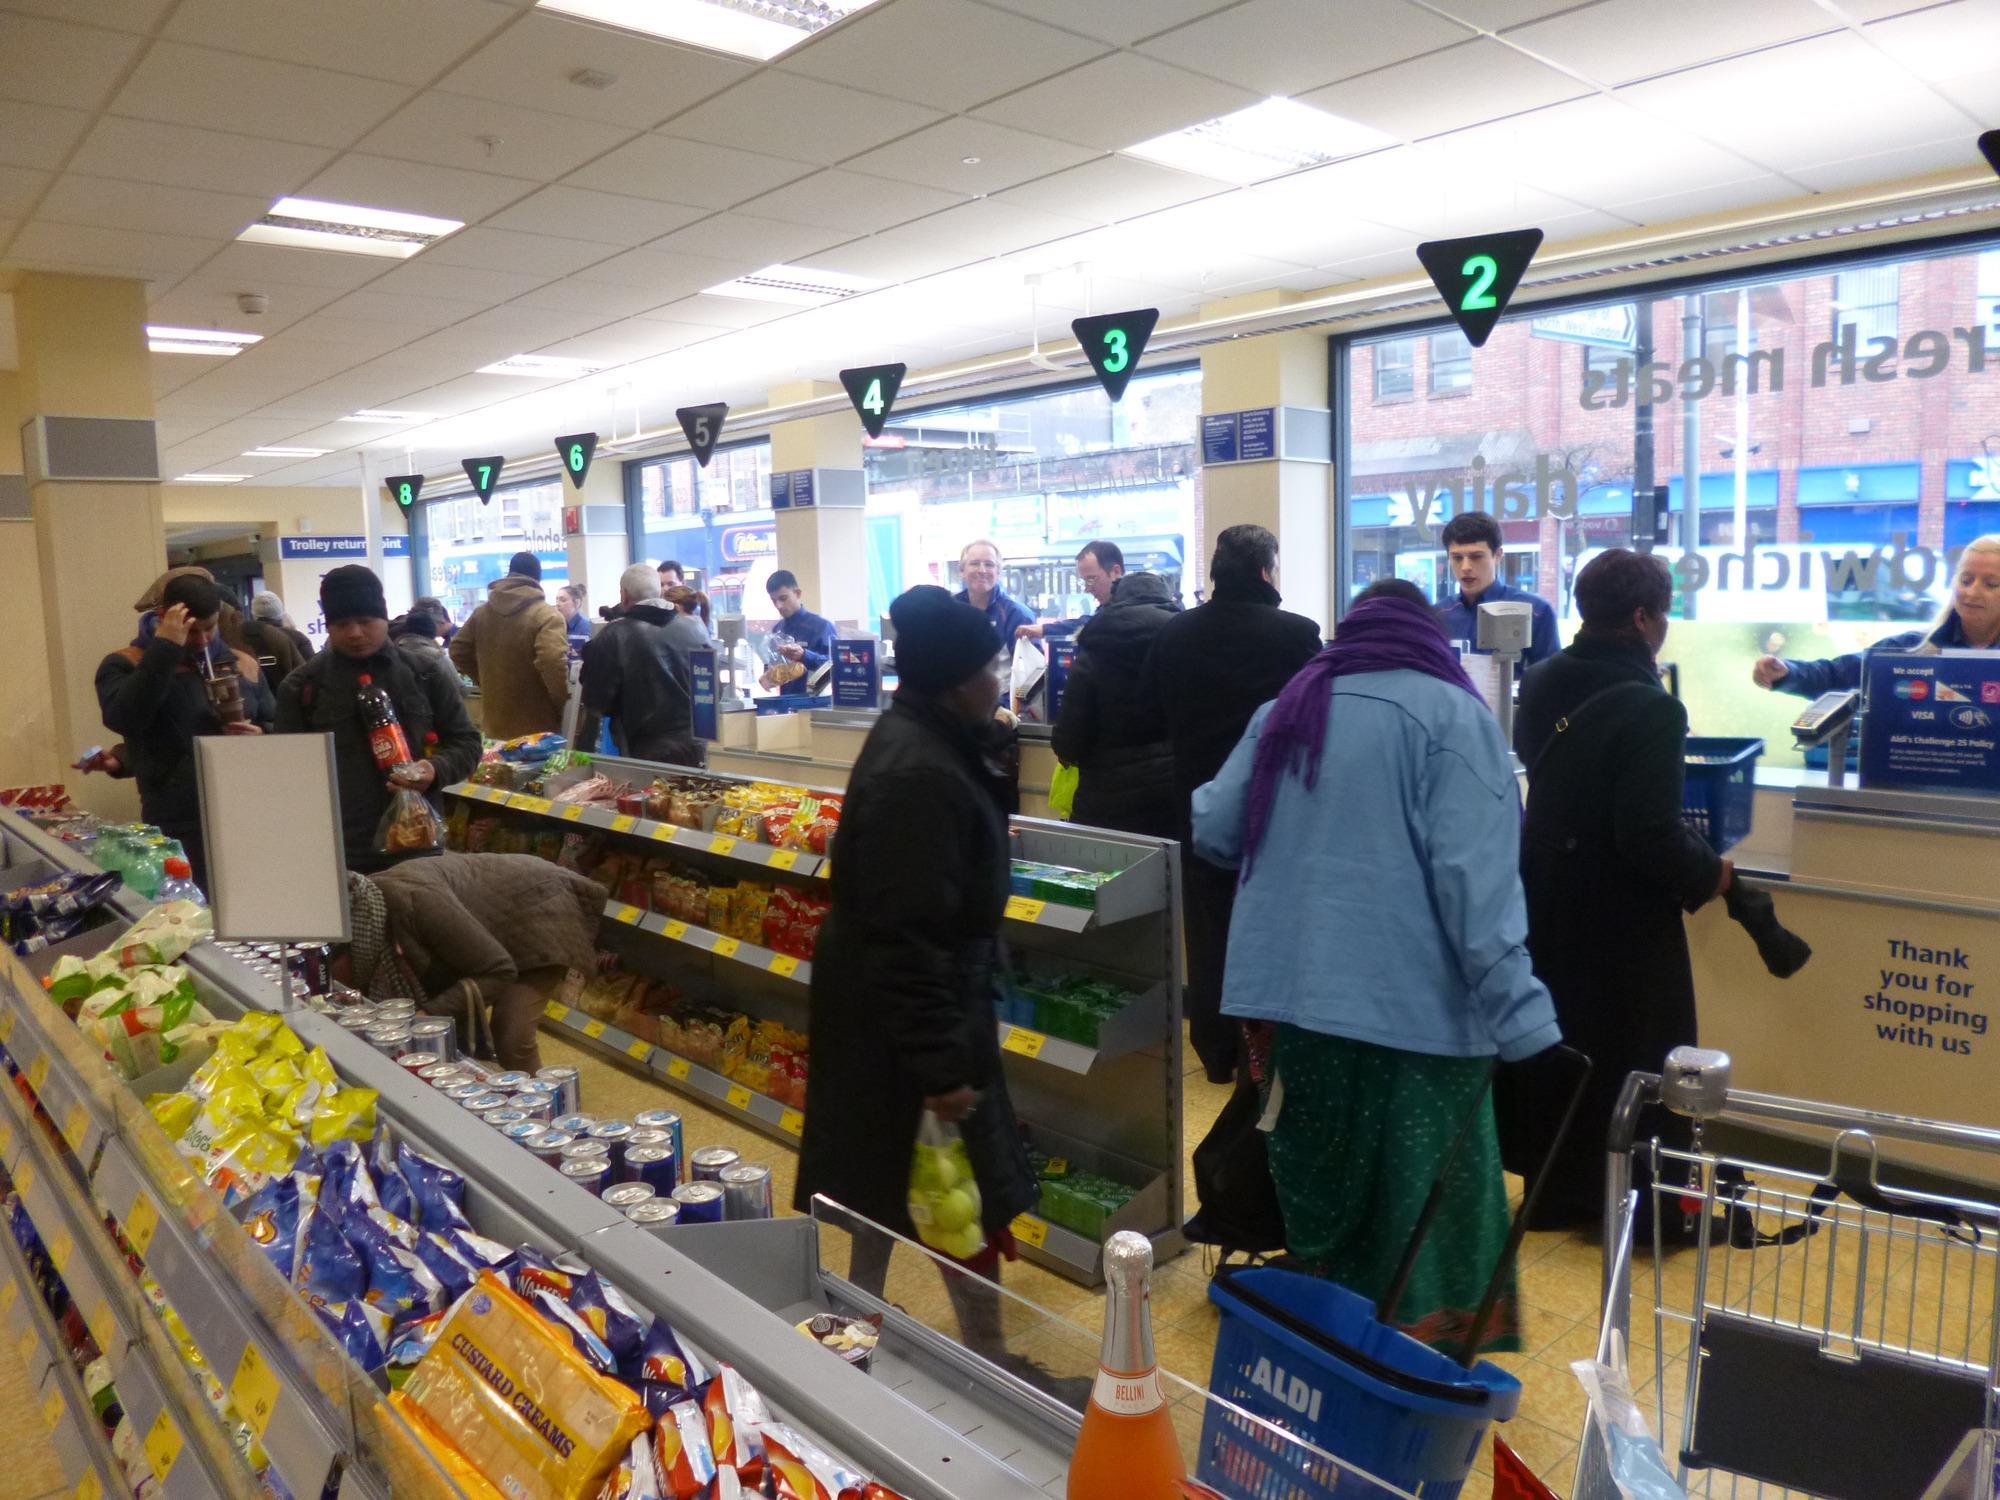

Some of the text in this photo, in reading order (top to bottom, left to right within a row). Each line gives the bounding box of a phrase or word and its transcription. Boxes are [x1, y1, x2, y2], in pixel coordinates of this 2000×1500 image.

[1461, 255, 1498, 311] 2
[1102, 328, 1130, 373] 3
[863, 378, 885, 415] 4
[695, 417, 710, 447] 5
[569, 444, 584, 472] 6
[478, 466, 491, 490] 7
[399, 483, 413, 505] 8
[289, 539, 331, 552] Trolley
[1893, 667, 1934, 677] We accept
[1911, 710, 1936, 721] VISA
[1913, 736, 1956, 747] Challenge
[1957, 738, 1968, 747] 25
[1968, 740, 1995, 750] Policy
[1887, 939, 1970, 970] Thank
[1880, 969, 1975, 998] you for
[1863, 991, 1988, 1035] shopping
[1876, 1023, 1972, 1055] with us
[450, 1332, 577, 1460] CUSTARD CREAMS
[1115, 1383, 1145, 1402] BELLINI
[1250, 1356, 1323, 1423] ALDI
